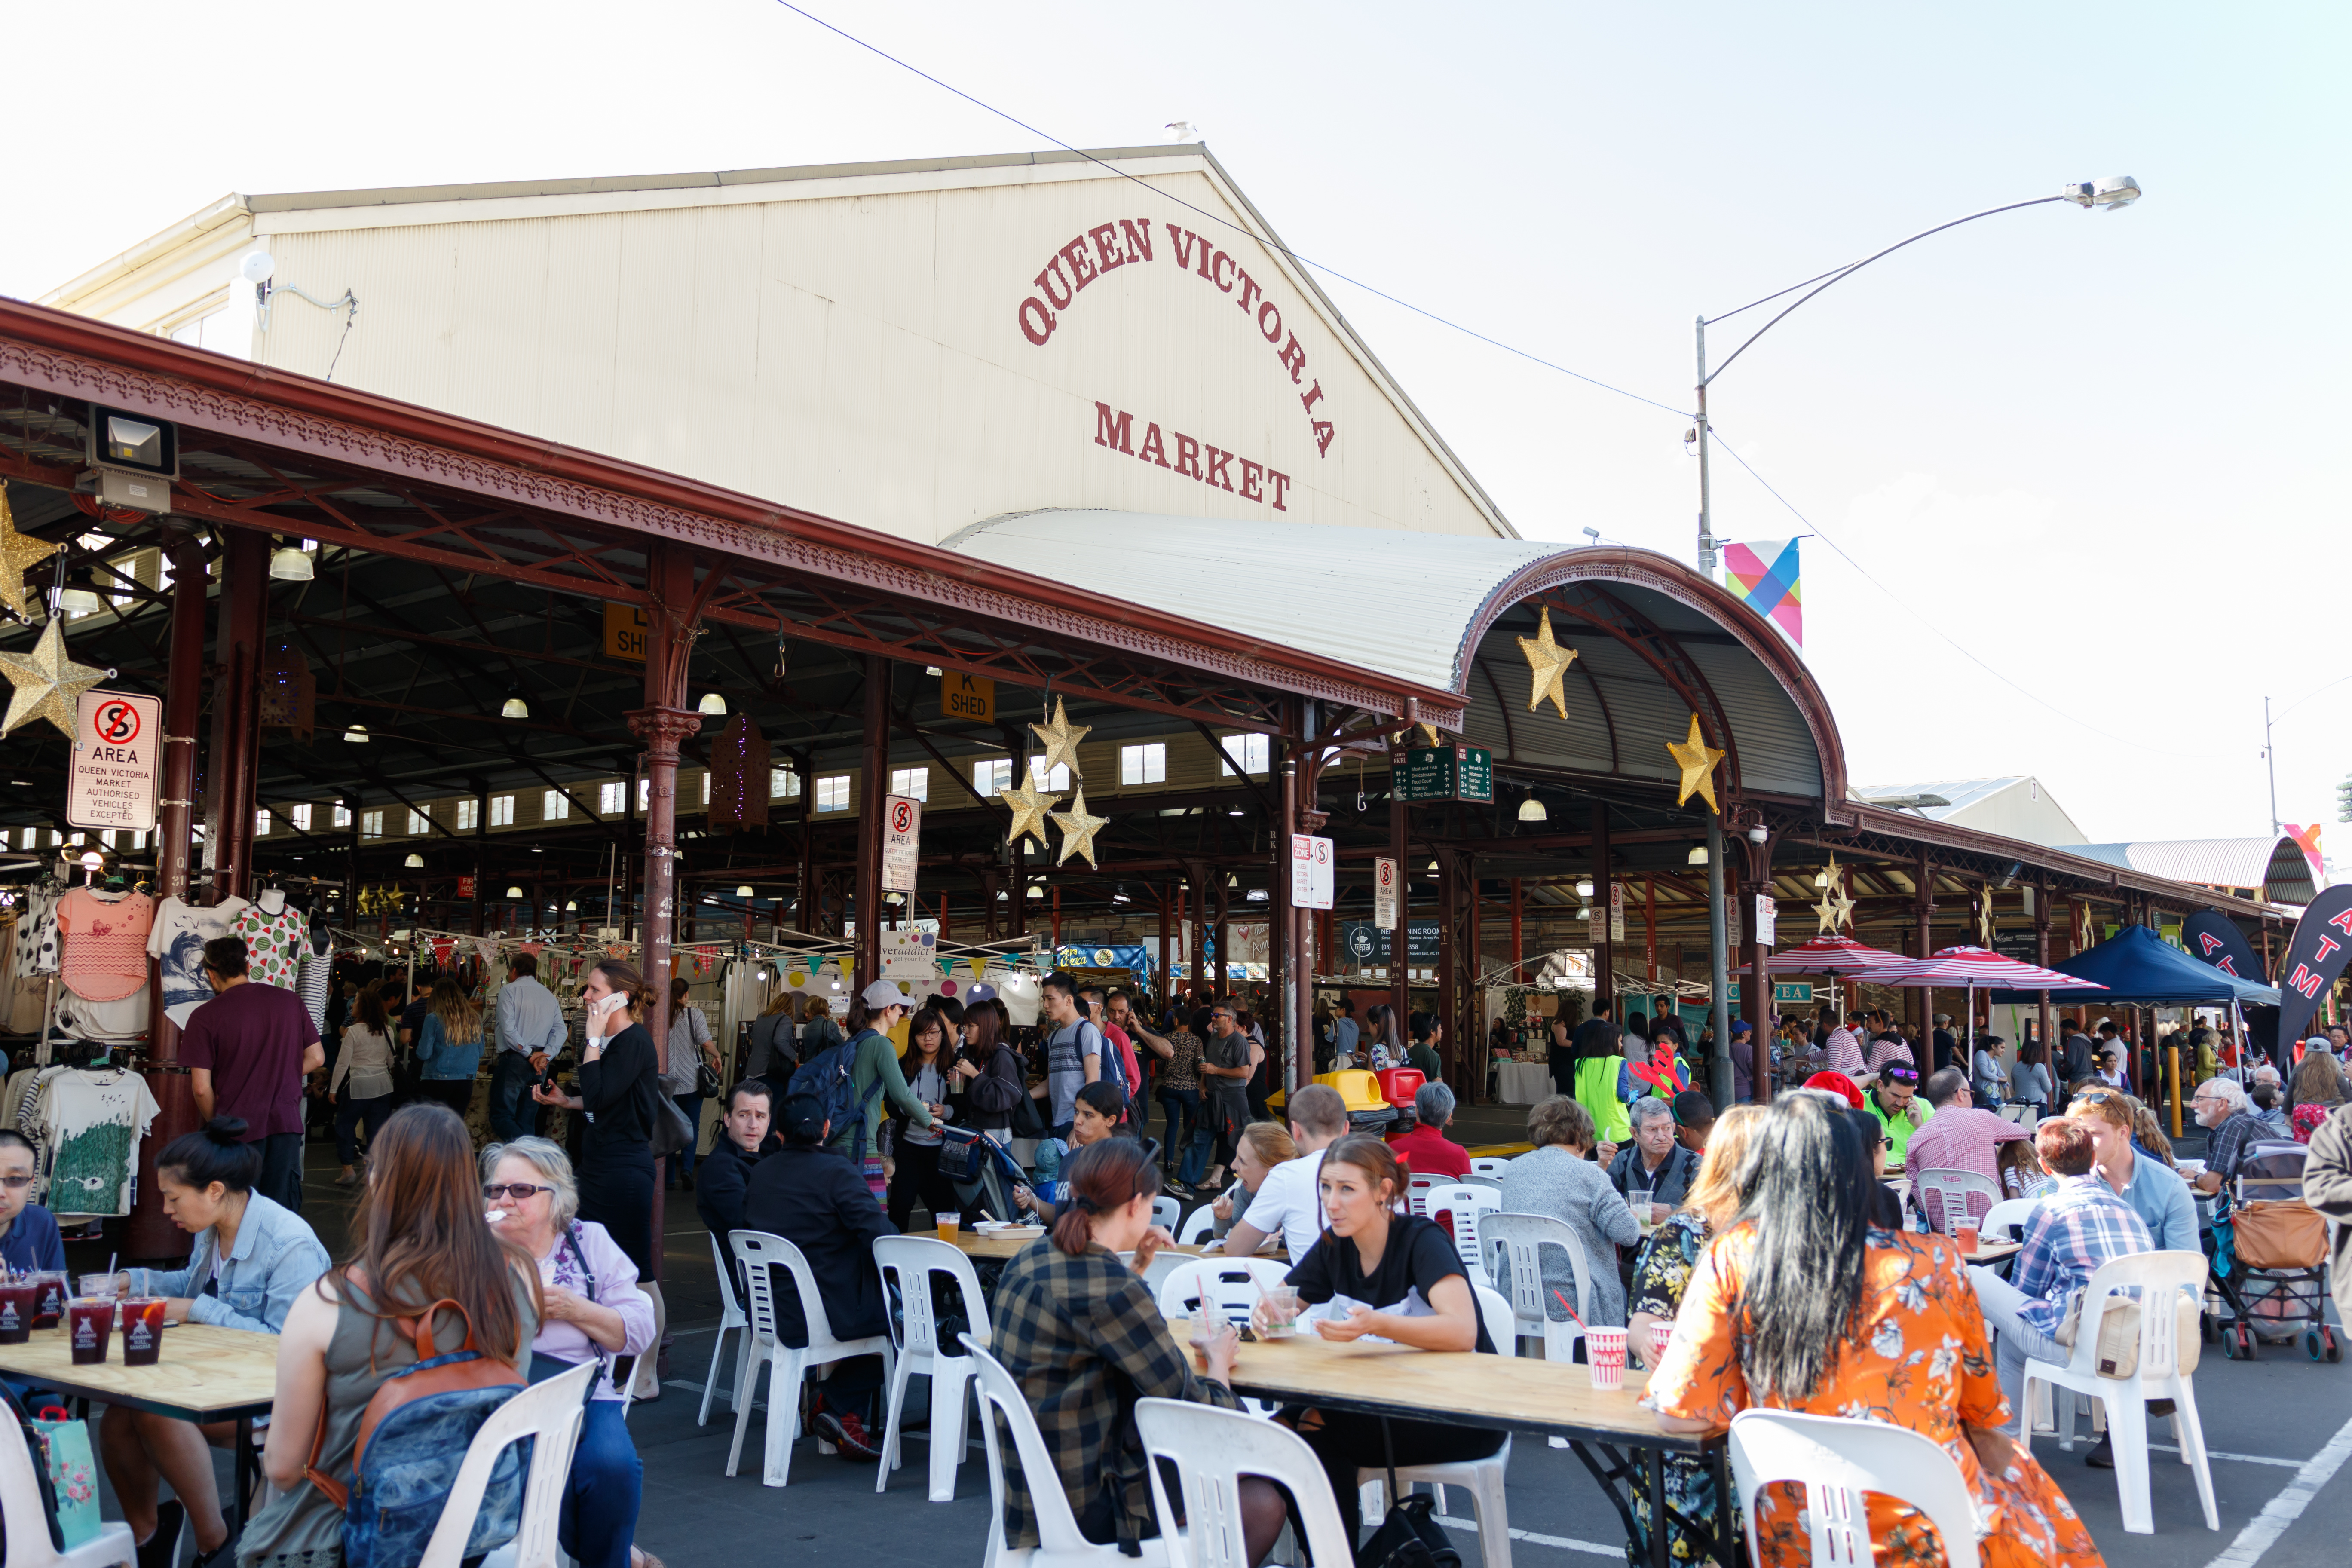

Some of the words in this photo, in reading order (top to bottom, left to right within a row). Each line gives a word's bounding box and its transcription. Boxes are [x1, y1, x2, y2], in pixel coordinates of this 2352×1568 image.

[1019, 218, 1153, 346] QUEEN
[1166, 223, 1334, 459] VICTORIA
[1094, 401, 1290, 512] MARKET
[618, 631, 647, 655] SH
[962, 674, 976, 692] K
[951, 693, 986, 716] SHED
[92, 747, 138, 764] AREA
[79, 766, 107, 775] QUEEN
[111, 769, 149, 779] VICTORIA
[96, 778, 131, 788] MARKET
[86, 788, 140, 799] AUTHORISED
[2032, 783, 2036, 799] J
[92, 799, 133, 809] VEHICLES
[90, 810, 133, 820] EXCEPTED
[891, 834, 910, 845] AREA
[1294, 839, 1310, 848] PERMIT
[1294, 848, 1309, 858] ZONE
[177, 857, 184, 868] Q
[1253, 940, 1269, 959] Am
[1354, 943, 1371, 952] nepal
[2288, 907, 2352, 999] ATM
[2199, 932, 2239, 977] AT
[1728, 986, 1737, 997] C
[1775, 986, 1803, 998] TEA
